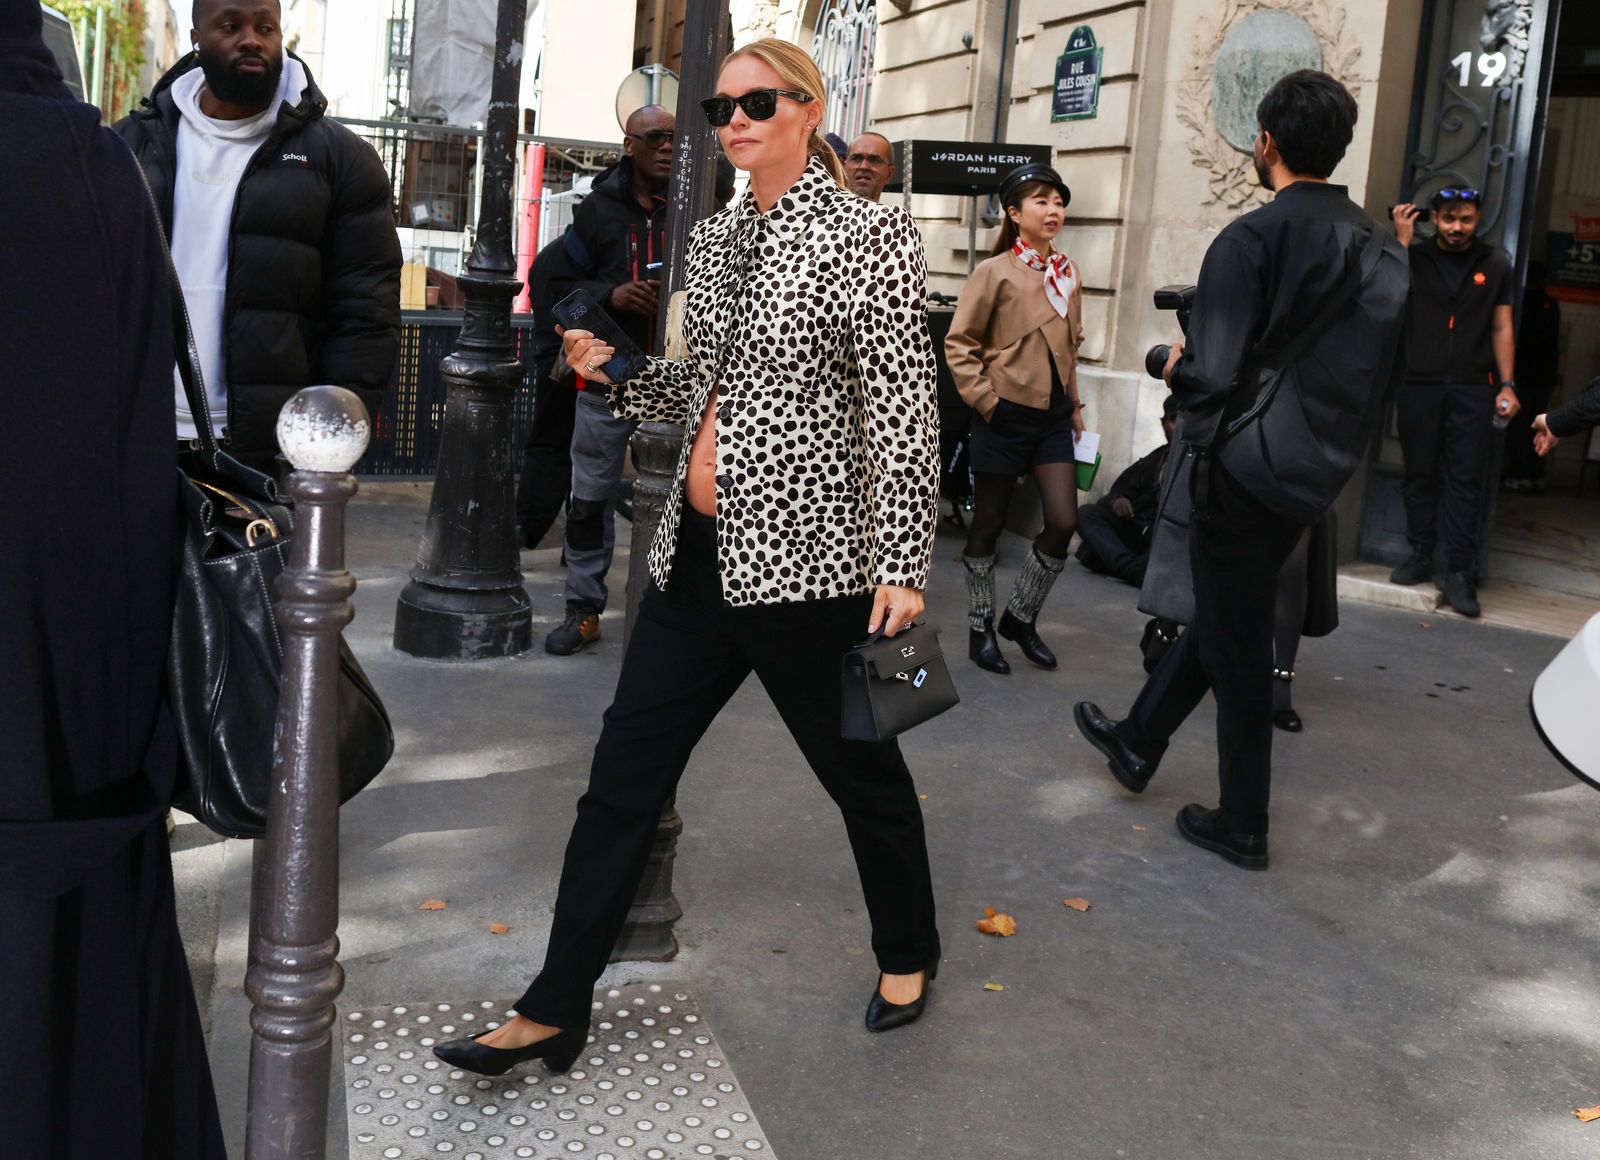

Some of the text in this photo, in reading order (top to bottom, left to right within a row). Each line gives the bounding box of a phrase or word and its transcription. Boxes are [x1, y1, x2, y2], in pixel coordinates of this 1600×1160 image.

[1071, 61, 1085, 75] RUE
[1451, 51, 1507, 87] 19
[1057, 73, 1096, 90] JULES COUSIN
[988, 154, 1032, 164] HERRY
[967, 166, 997, 174] PARIS
[570, 305, 588, 320] 2:50
